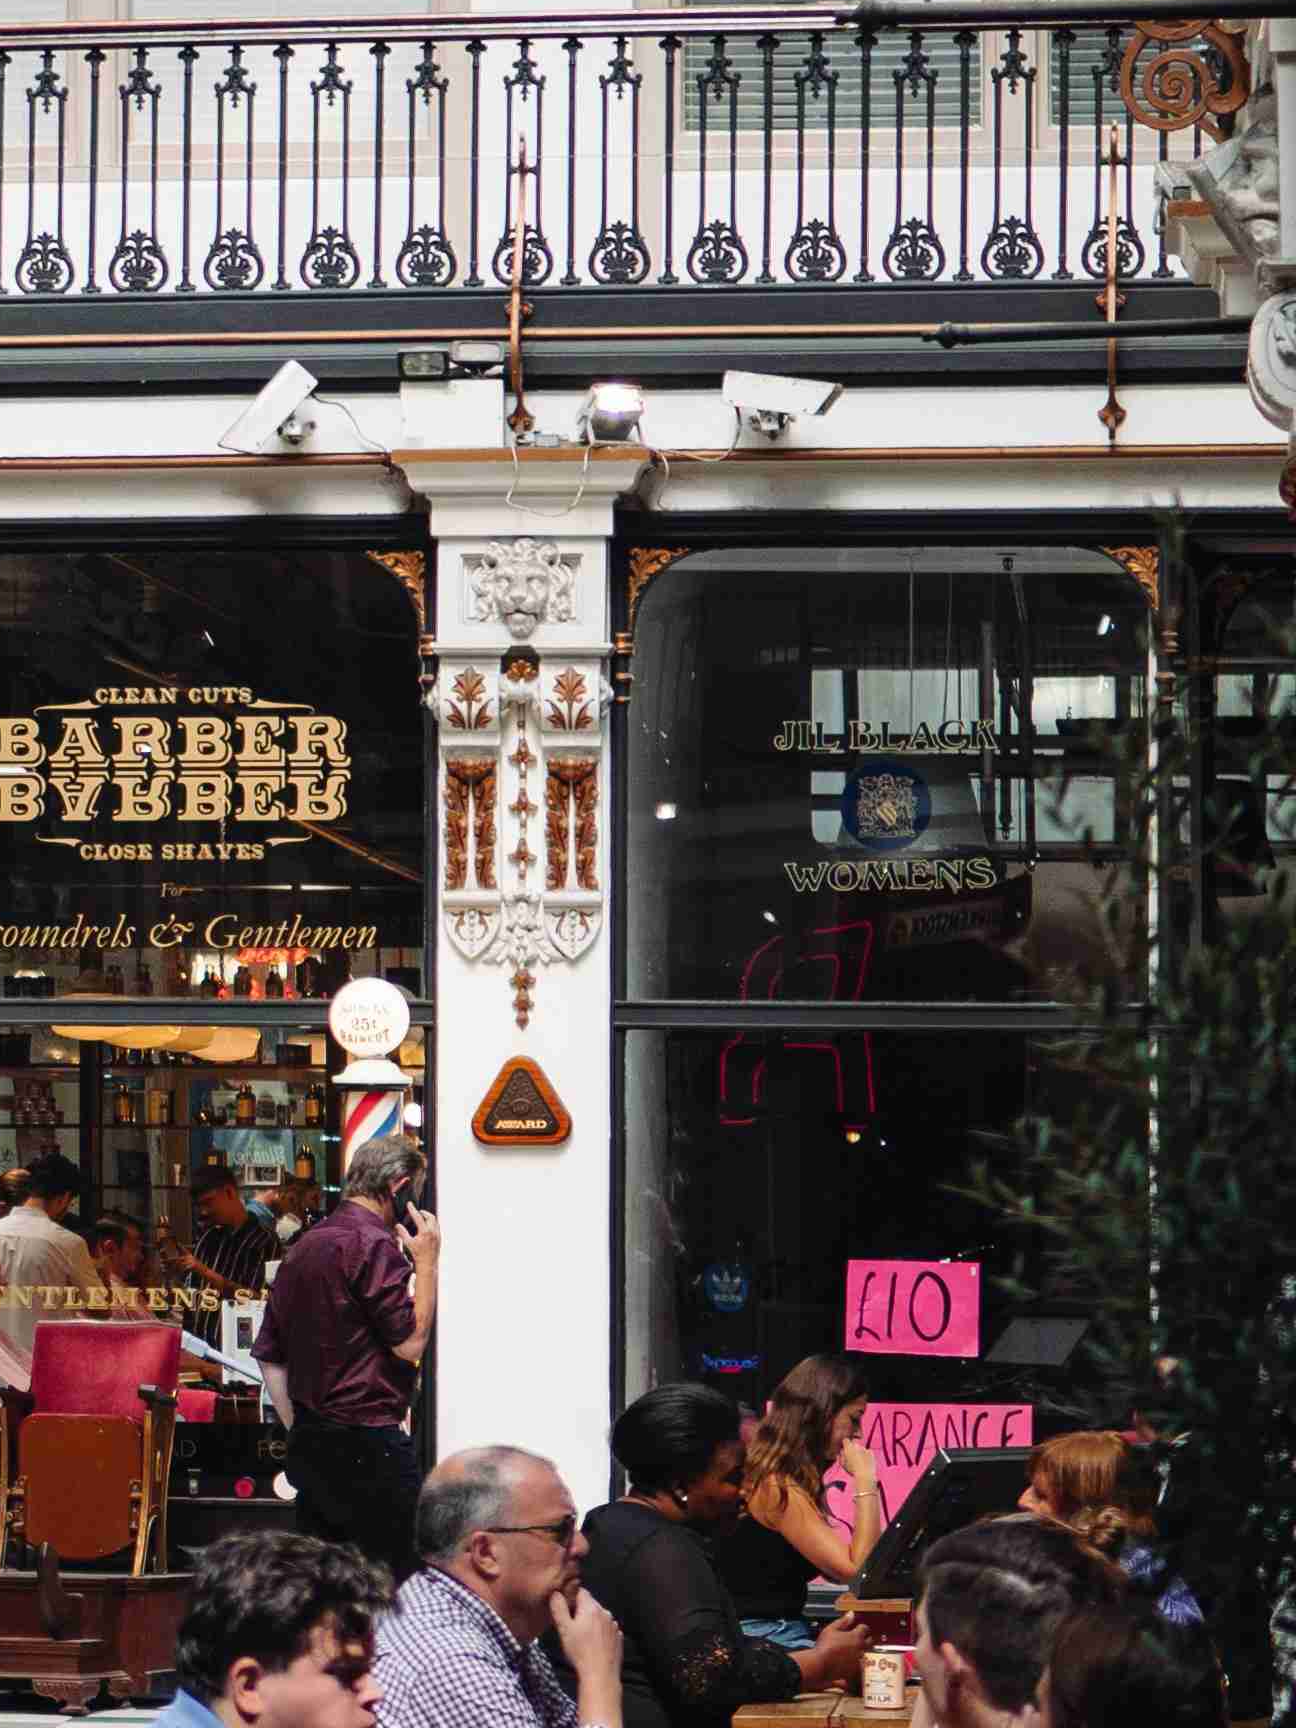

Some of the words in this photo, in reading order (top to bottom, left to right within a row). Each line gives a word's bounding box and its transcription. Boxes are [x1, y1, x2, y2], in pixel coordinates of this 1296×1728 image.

[95, 687, 178, 704] CLEAN
[189, 687, 253, 704] CUTS
[774, 720, 840, 751] JIL
[849, 719, 998, 751] BLACK
[80, 843, 152, 861] CLOSE
[162, 843, 265, 861] SHAVES
[784, 856, 998, 893] WOMENS
[160, 881, 185, 898] For
[149, 914, 194, 948] &
[205, 914, 377, 948] Gentlemen
[495, 1119, 548, 1129] AWARD
[854, 1270, 952, 1342] £10
